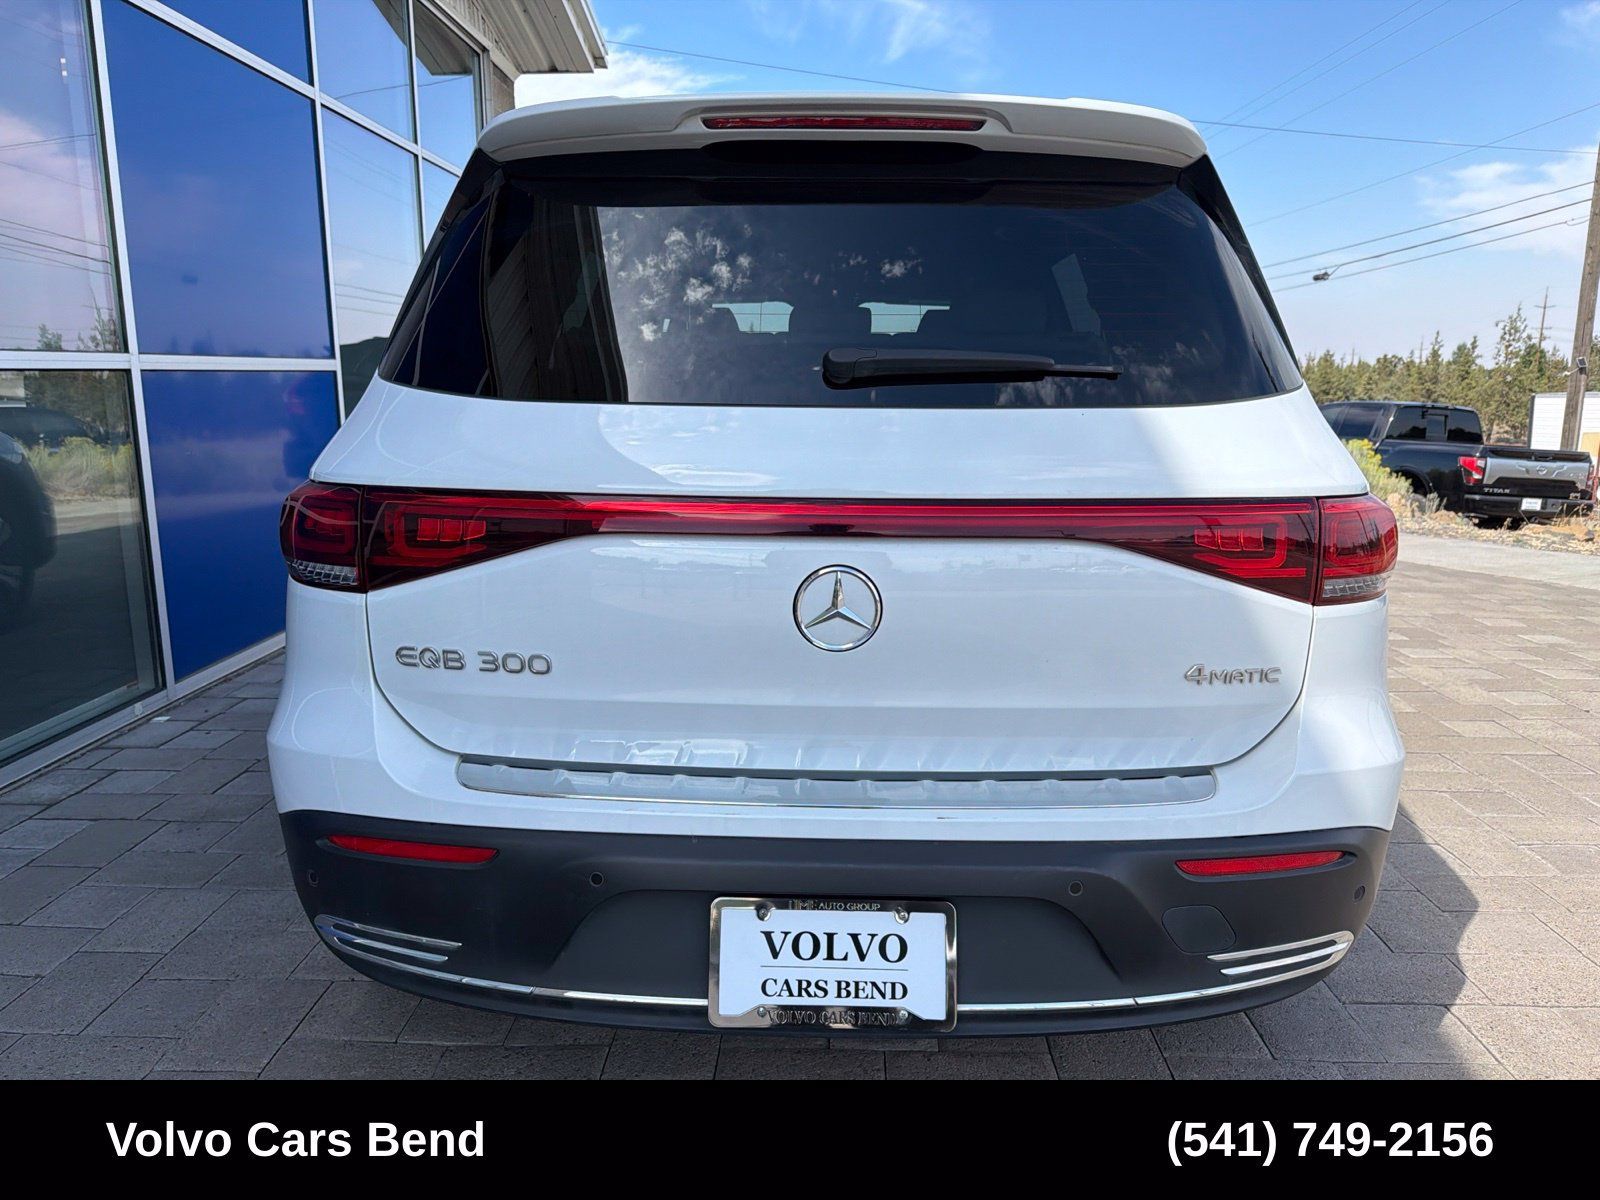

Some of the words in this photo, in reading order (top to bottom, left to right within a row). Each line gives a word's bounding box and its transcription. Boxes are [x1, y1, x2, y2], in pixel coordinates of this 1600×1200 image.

[395, 645, 466, 671] EQB
[477, 650, 553, 675] 300
[1184, 663, 1282, 685] 4MATIC
[818, 902, 845, 911] AUTO
[846, 902, 881, 911] GROUP
[761, 931, 908, 963] VOLVO
[761, 978, 829, 999] CARS
[834, 980, 908, 1000] BEND
[767, 1010, 817, 1025] VOLVO
[819, 1011, 856, 1025] CARS
[858, 1011, 898, 1027] BEND
